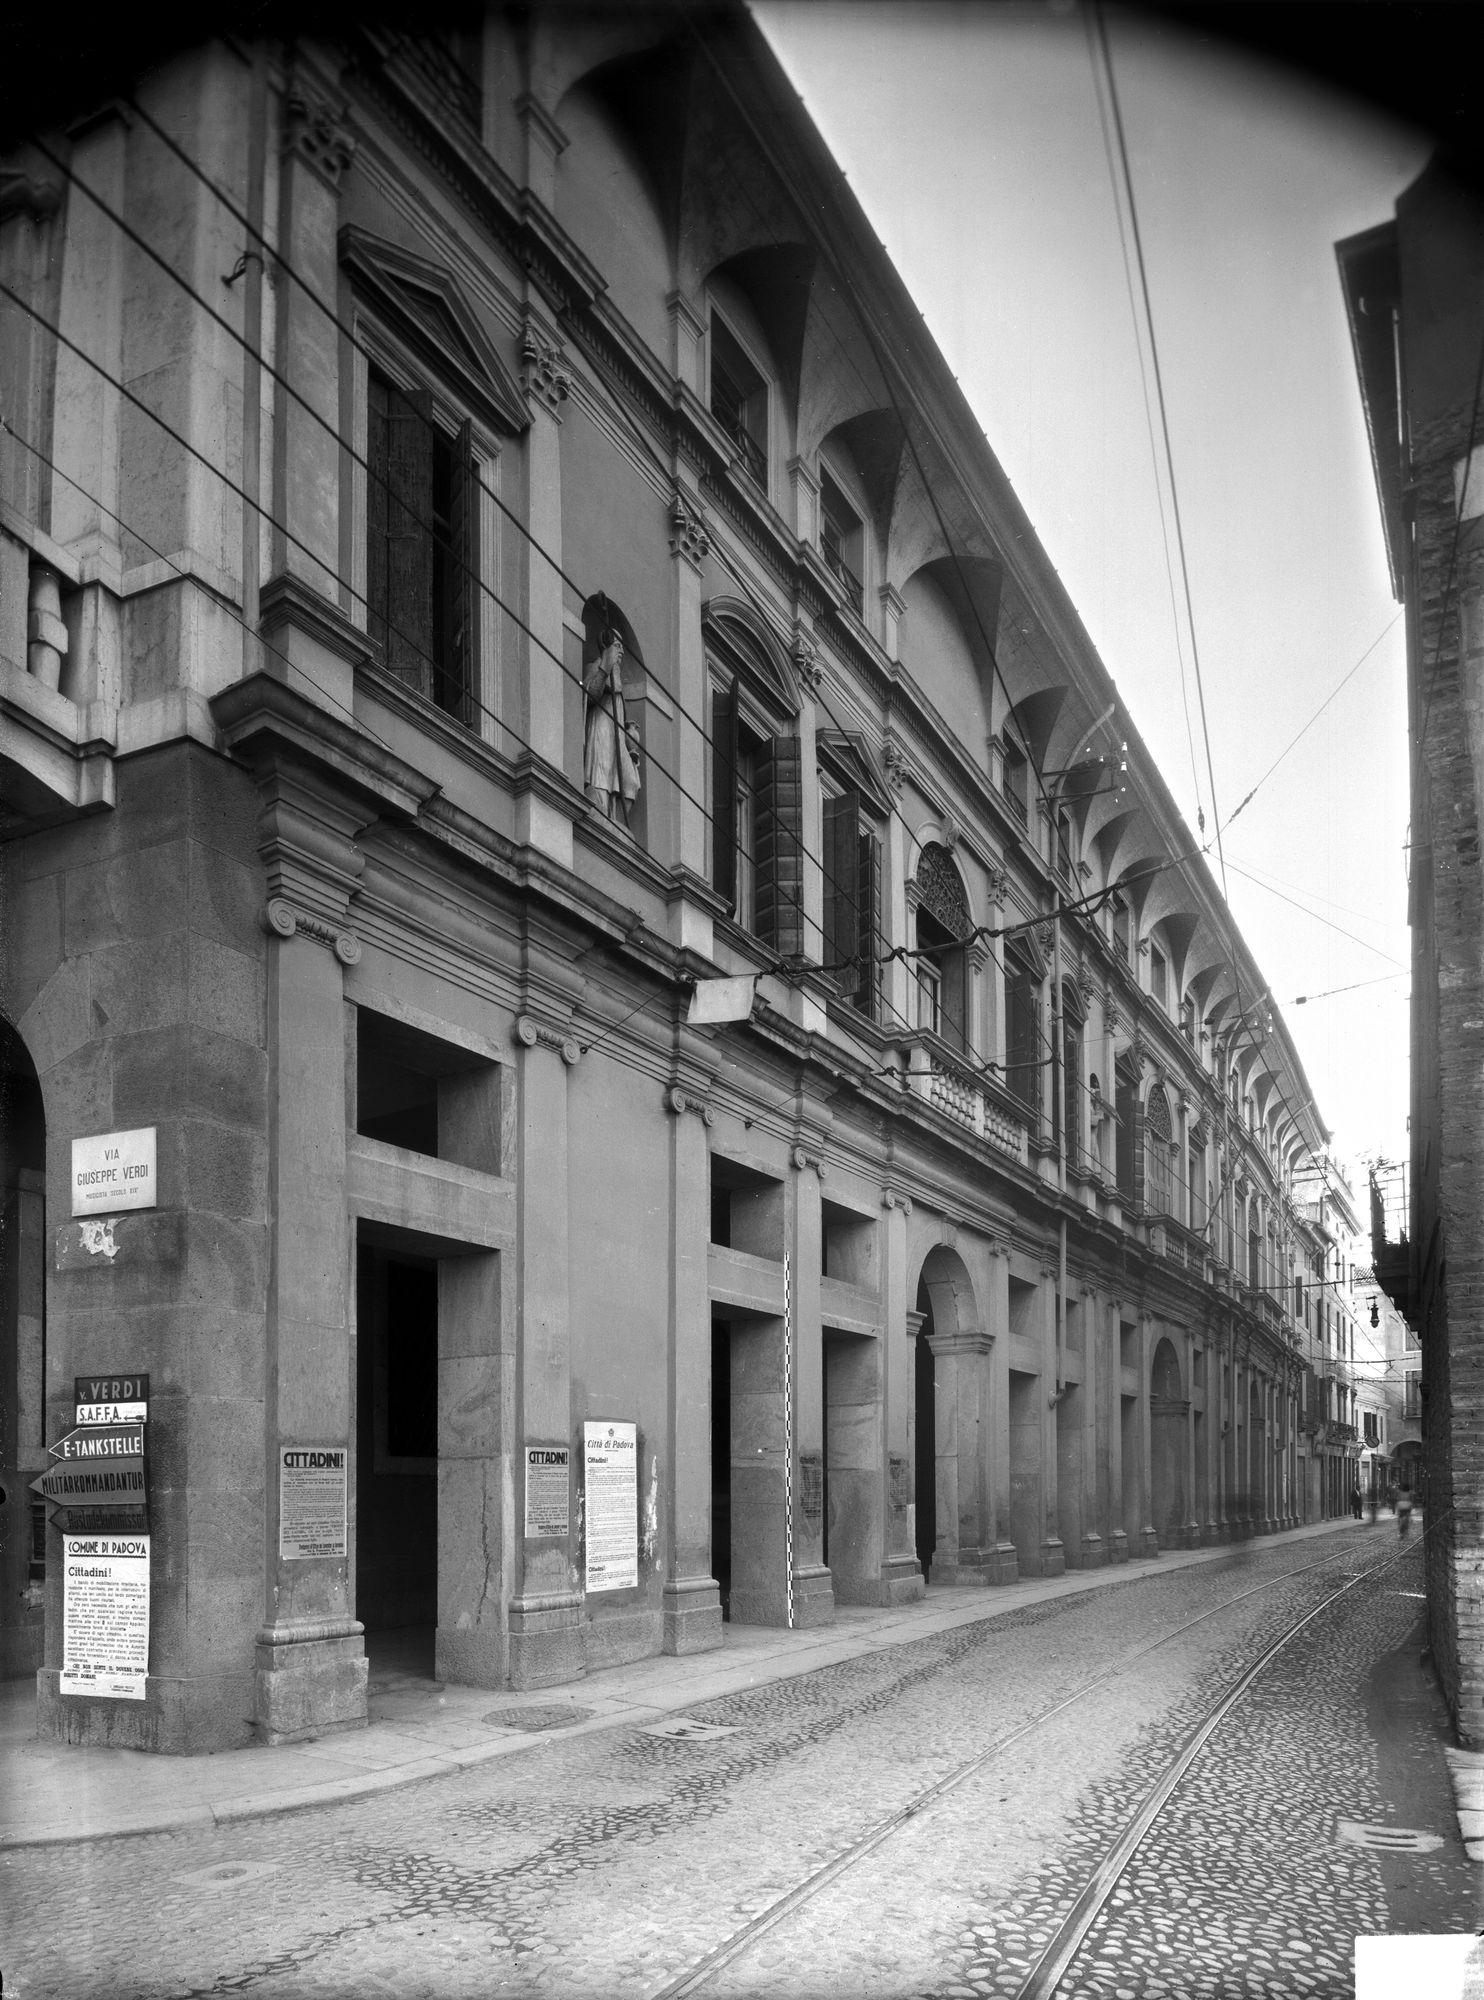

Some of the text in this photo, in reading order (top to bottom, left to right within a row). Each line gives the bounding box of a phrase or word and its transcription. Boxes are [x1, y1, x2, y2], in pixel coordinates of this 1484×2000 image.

[104, 1148, 120, 1161] VIA
[77, 1164, 149, 1186] GIUSEPPE VERDI
[90, 1380, 141, 1400] VERDI
[79, 1405, 122, 1421] S.A.F.F.A.
[63, 1436, 141, 1457] E-TANKSTELLE
[587, 1439, 634, 1449] Città di Padova
[284, 1452, 344, 1467] CITTADINI!
[529, 1451, 568, 1464] CITTADINI!
[41, 1471, 144, 1494] MILITÄRKOMMANDANTUR
[68, 1541, 147, 1555] COMUNE DI PADOVA
[68, 1566, 112, 1578] Cittadini!
